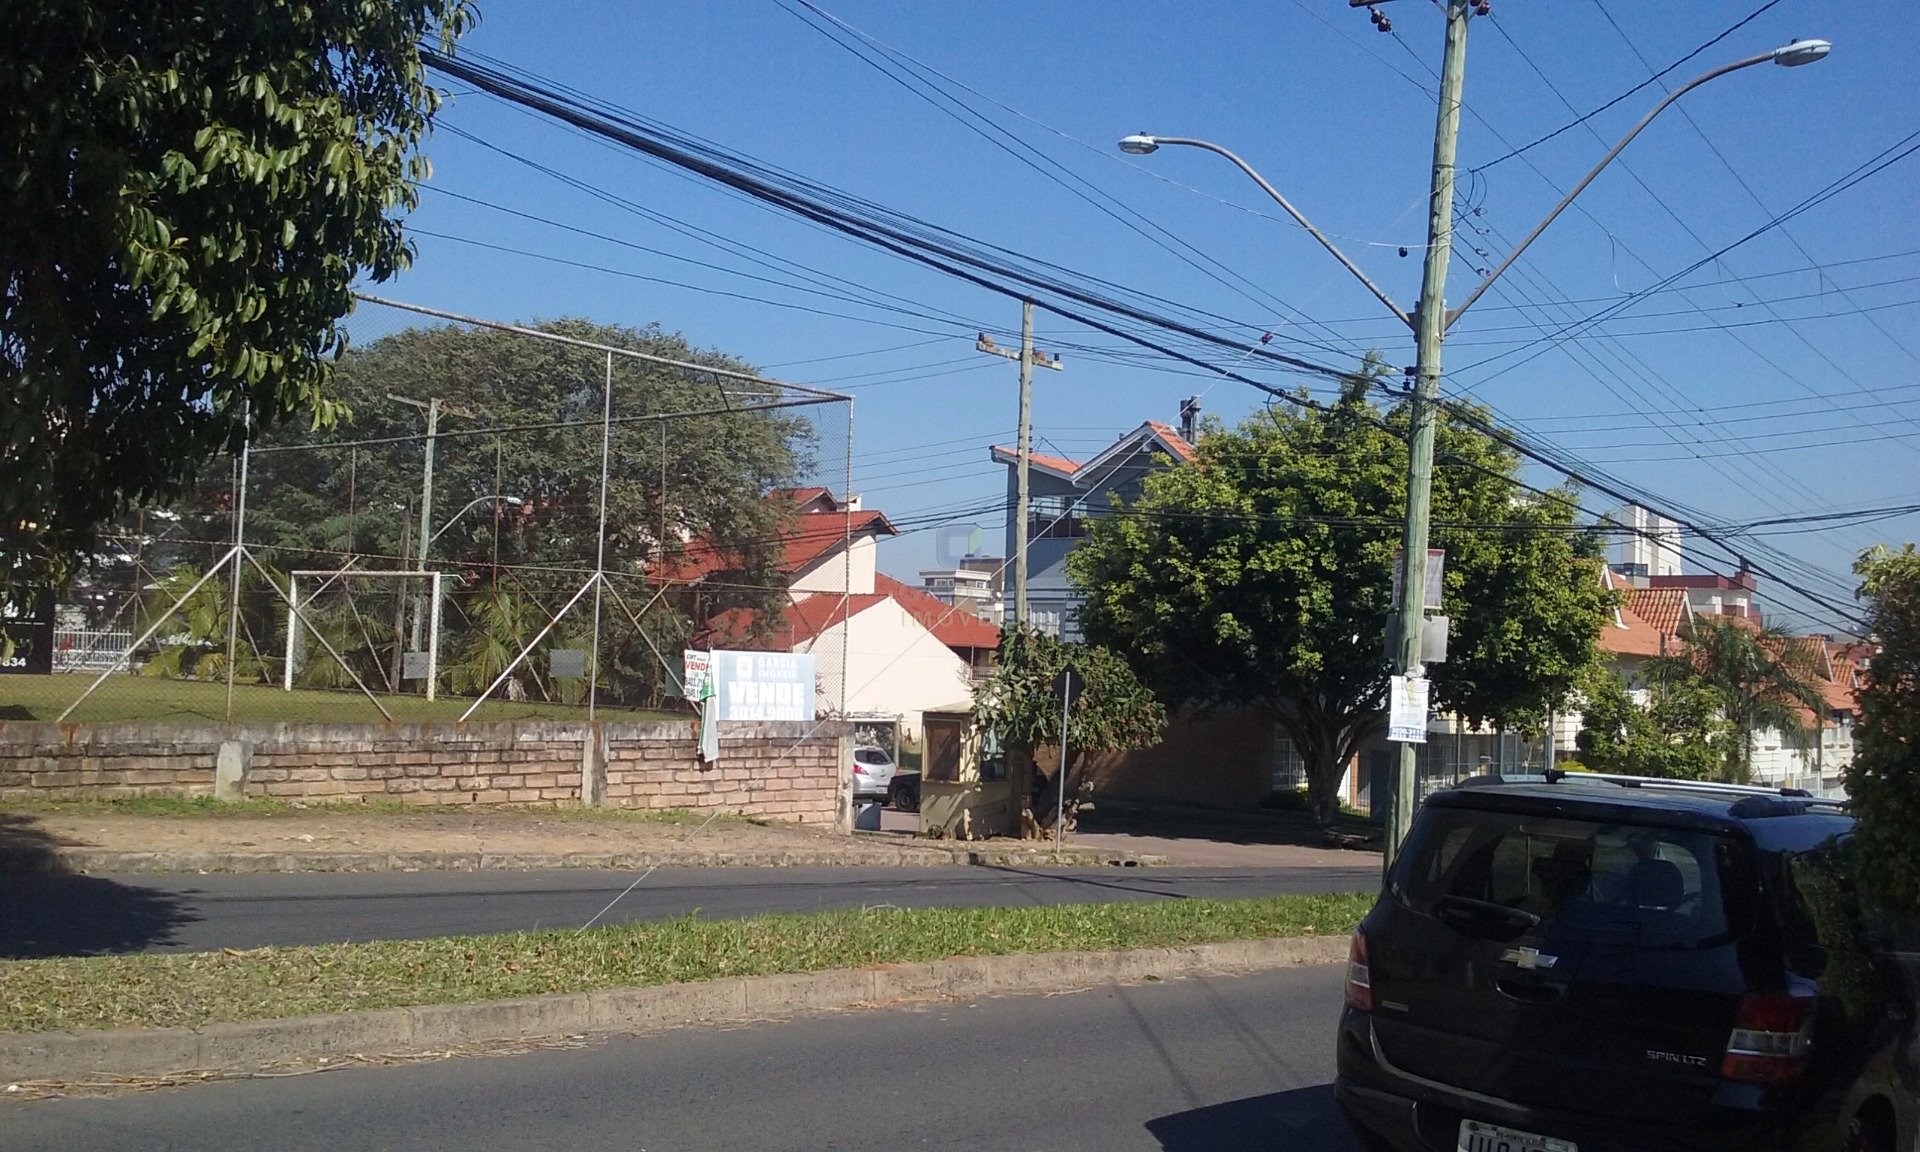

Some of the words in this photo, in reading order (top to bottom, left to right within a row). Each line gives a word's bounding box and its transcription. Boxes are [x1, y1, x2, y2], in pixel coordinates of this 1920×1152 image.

[757, 656, 797, 669] GARCIA
[728, 681, 805, 704] VENDE
[1646, 1050, 1680, 1062] SPIN
[1682, 1055, 1707, 1066] LTZ
